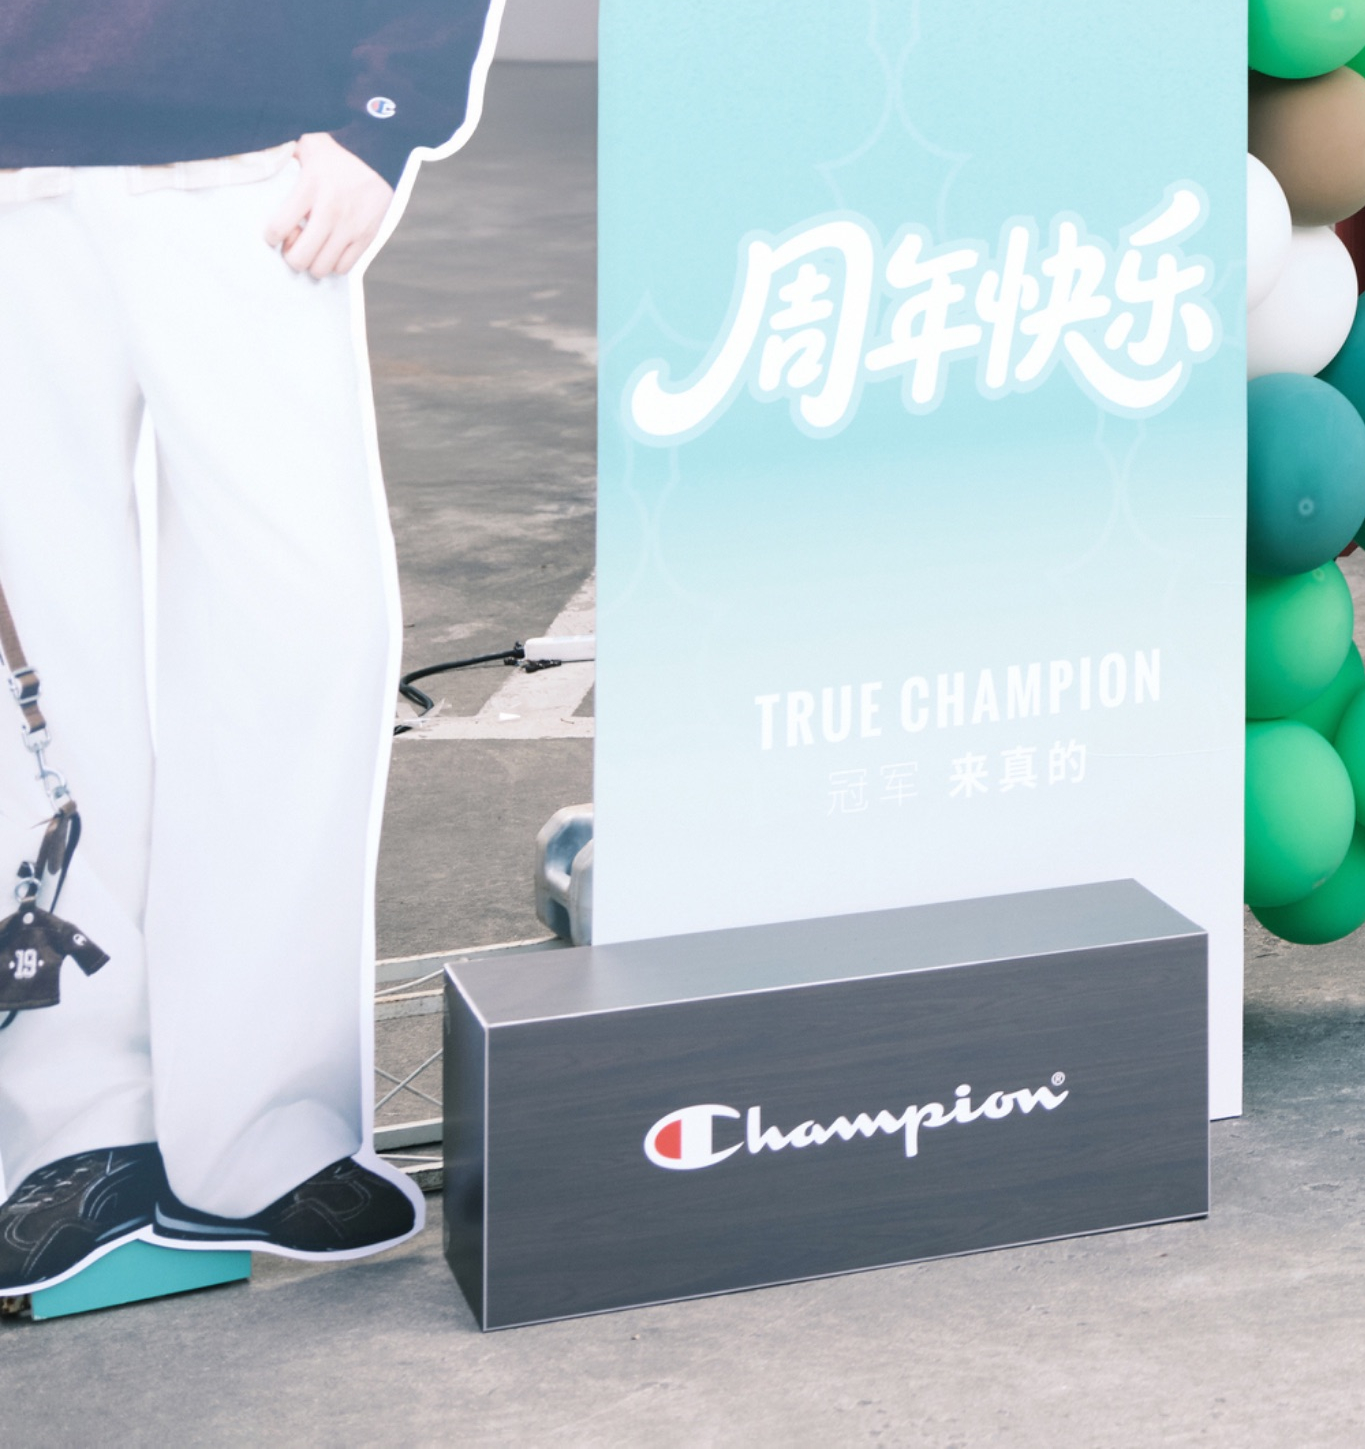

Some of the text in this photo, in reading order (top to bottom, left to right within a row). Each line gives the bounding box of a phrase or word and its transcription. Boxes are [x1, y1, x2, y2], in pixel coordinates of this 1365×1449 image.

[630, 188, 1215, 437] 周年快乐
[753, 647, 1163, 751] TRUE CHAMPION
[825, 737, 1088, 817] 冠军 来真的
[14, 948, 38, 980] 19
